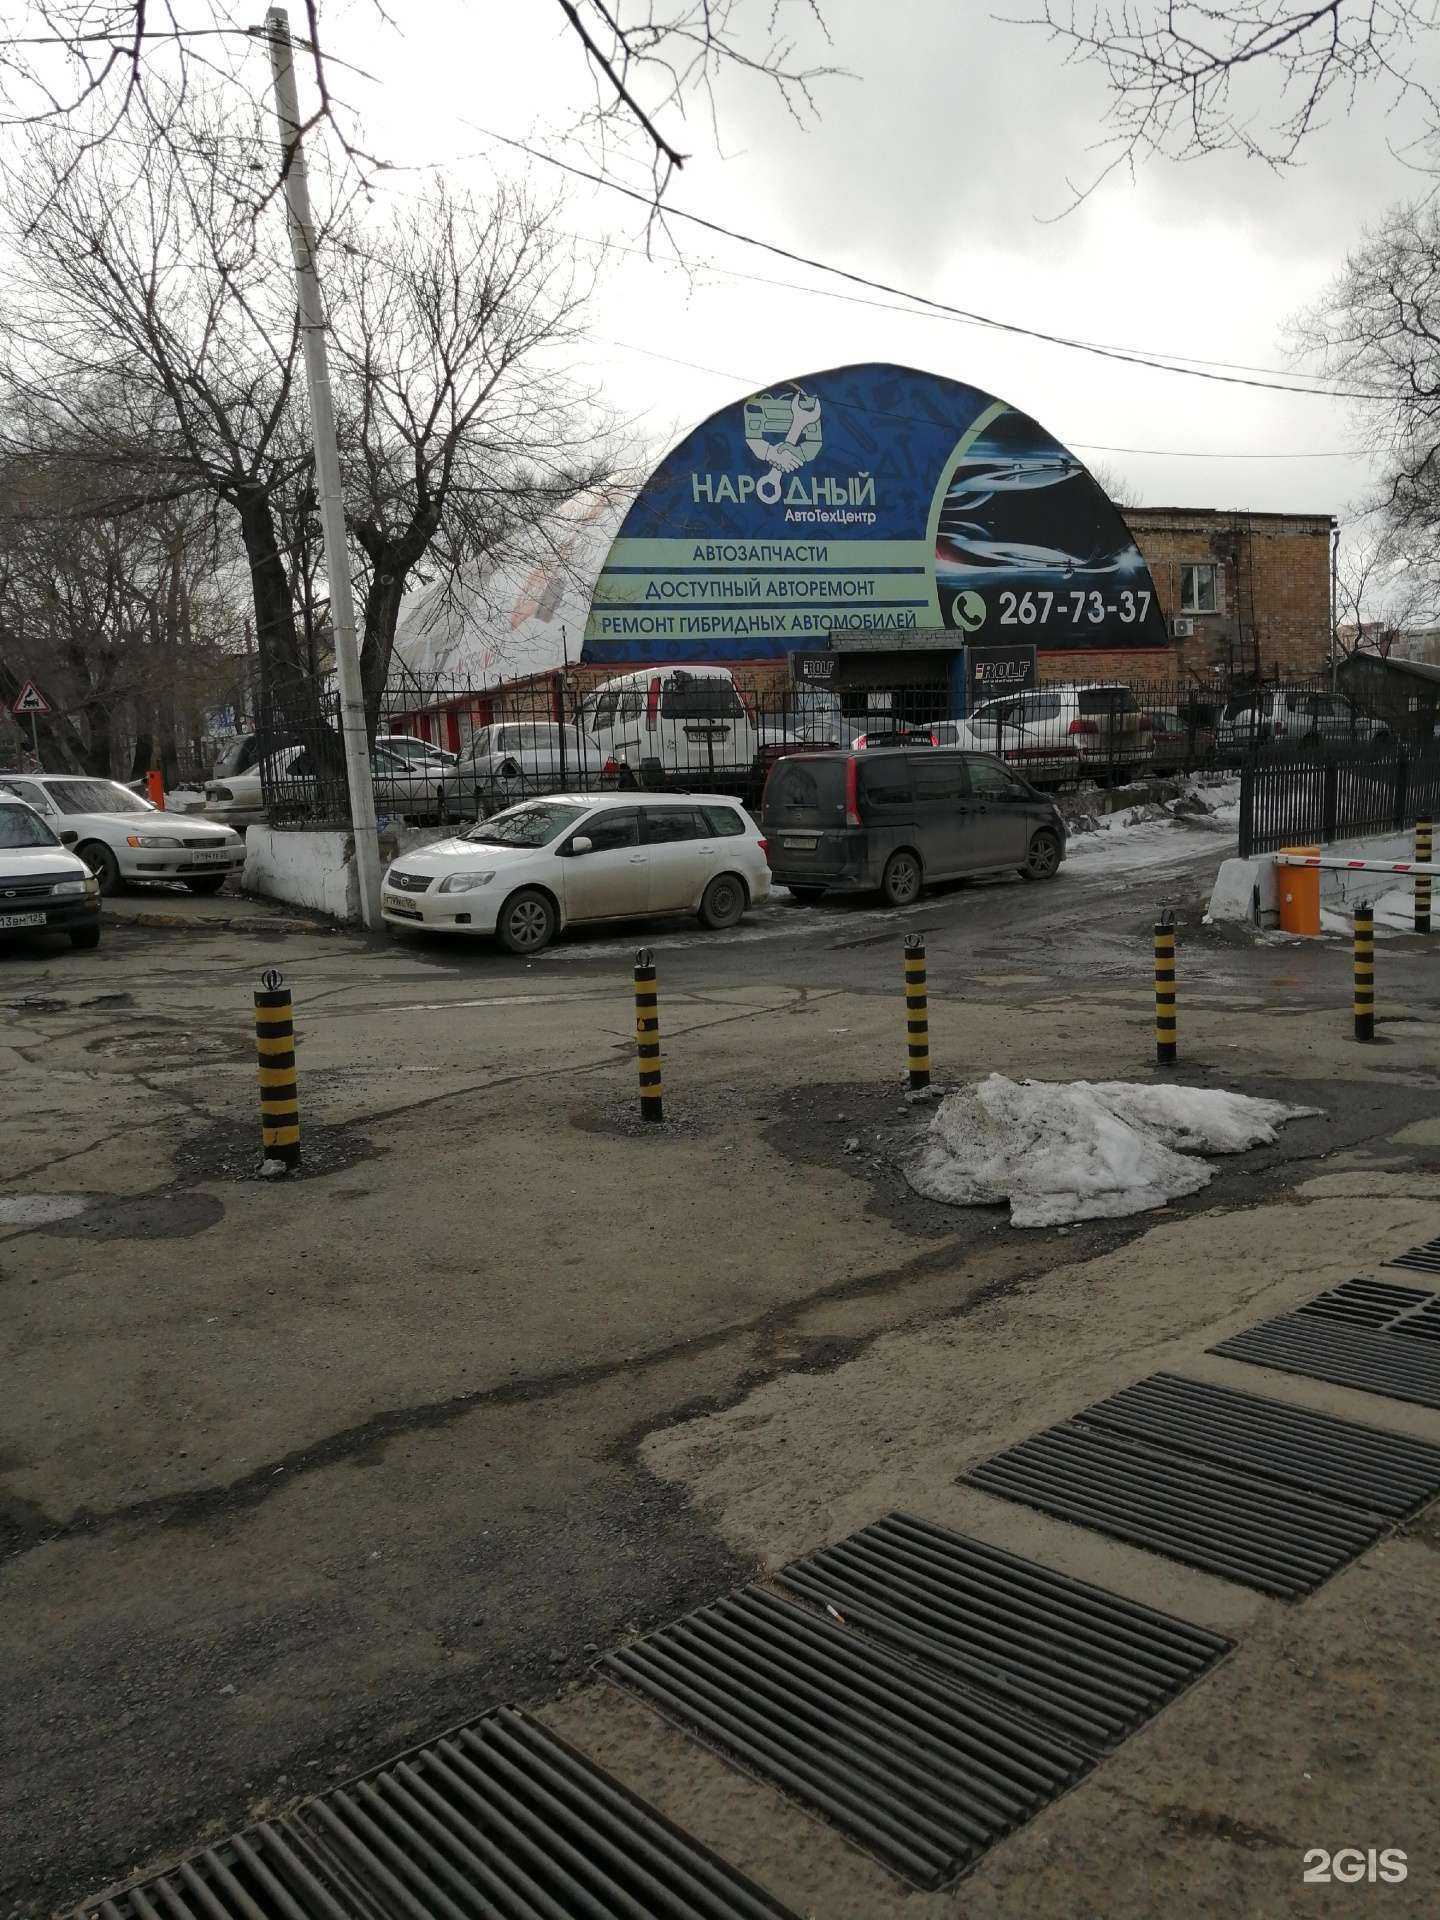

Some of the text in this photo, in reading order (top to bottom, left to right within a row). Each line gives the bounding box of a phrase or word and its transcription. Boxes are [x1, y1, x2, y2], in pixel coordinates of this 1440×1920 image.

[692, 471, 876, 505] НАРОДНЫЙ
[785, 509, 876, 525] АвтоТехЦентр
[693, 545, 828, 562] АВТОЗАПЧАСТИ
[645, 577, 875, 599] ДОСТУПНЫЙ АВТОРЕМОНТ
[999, 590, 1151, 624] 267-73-37
[602, 609, 917, 634] РЕМОНТ ГИБРИДНЫХ АВТОМОБИЛЕЙ
[807, 660, 834, 675] ROLF
[982, 660, 1031, 679] ROLF
